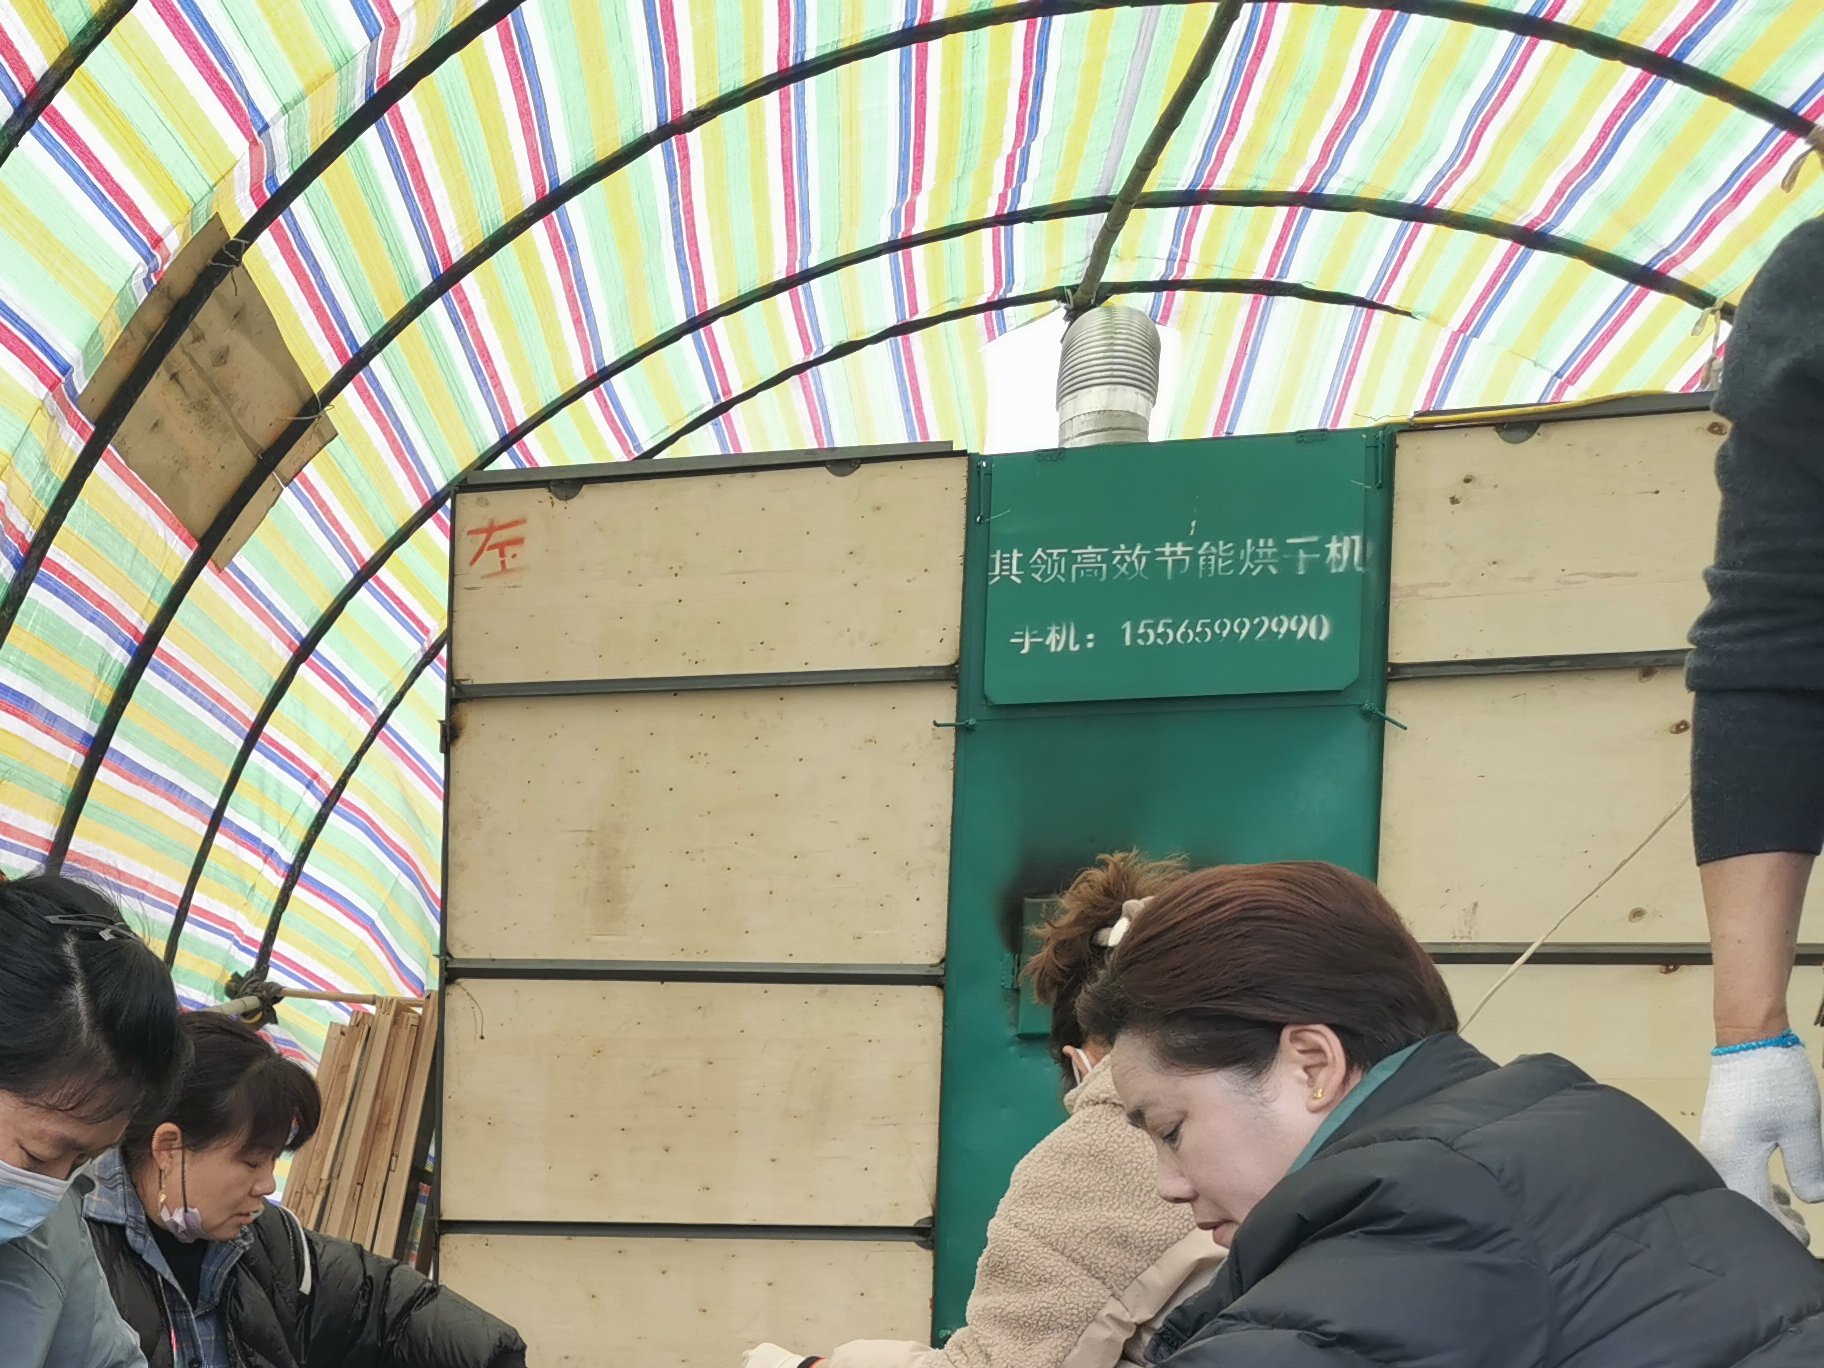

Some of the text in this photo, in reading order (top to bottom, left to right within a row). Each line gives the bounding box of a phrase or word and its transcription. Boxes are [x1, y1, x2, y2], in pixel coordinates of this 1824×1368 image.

[467, 518, 528, 579] 左
[988, 534, 1366, 585] 其领高效节能烘干机
[1120, 614, 1331, 647] 15565992990
